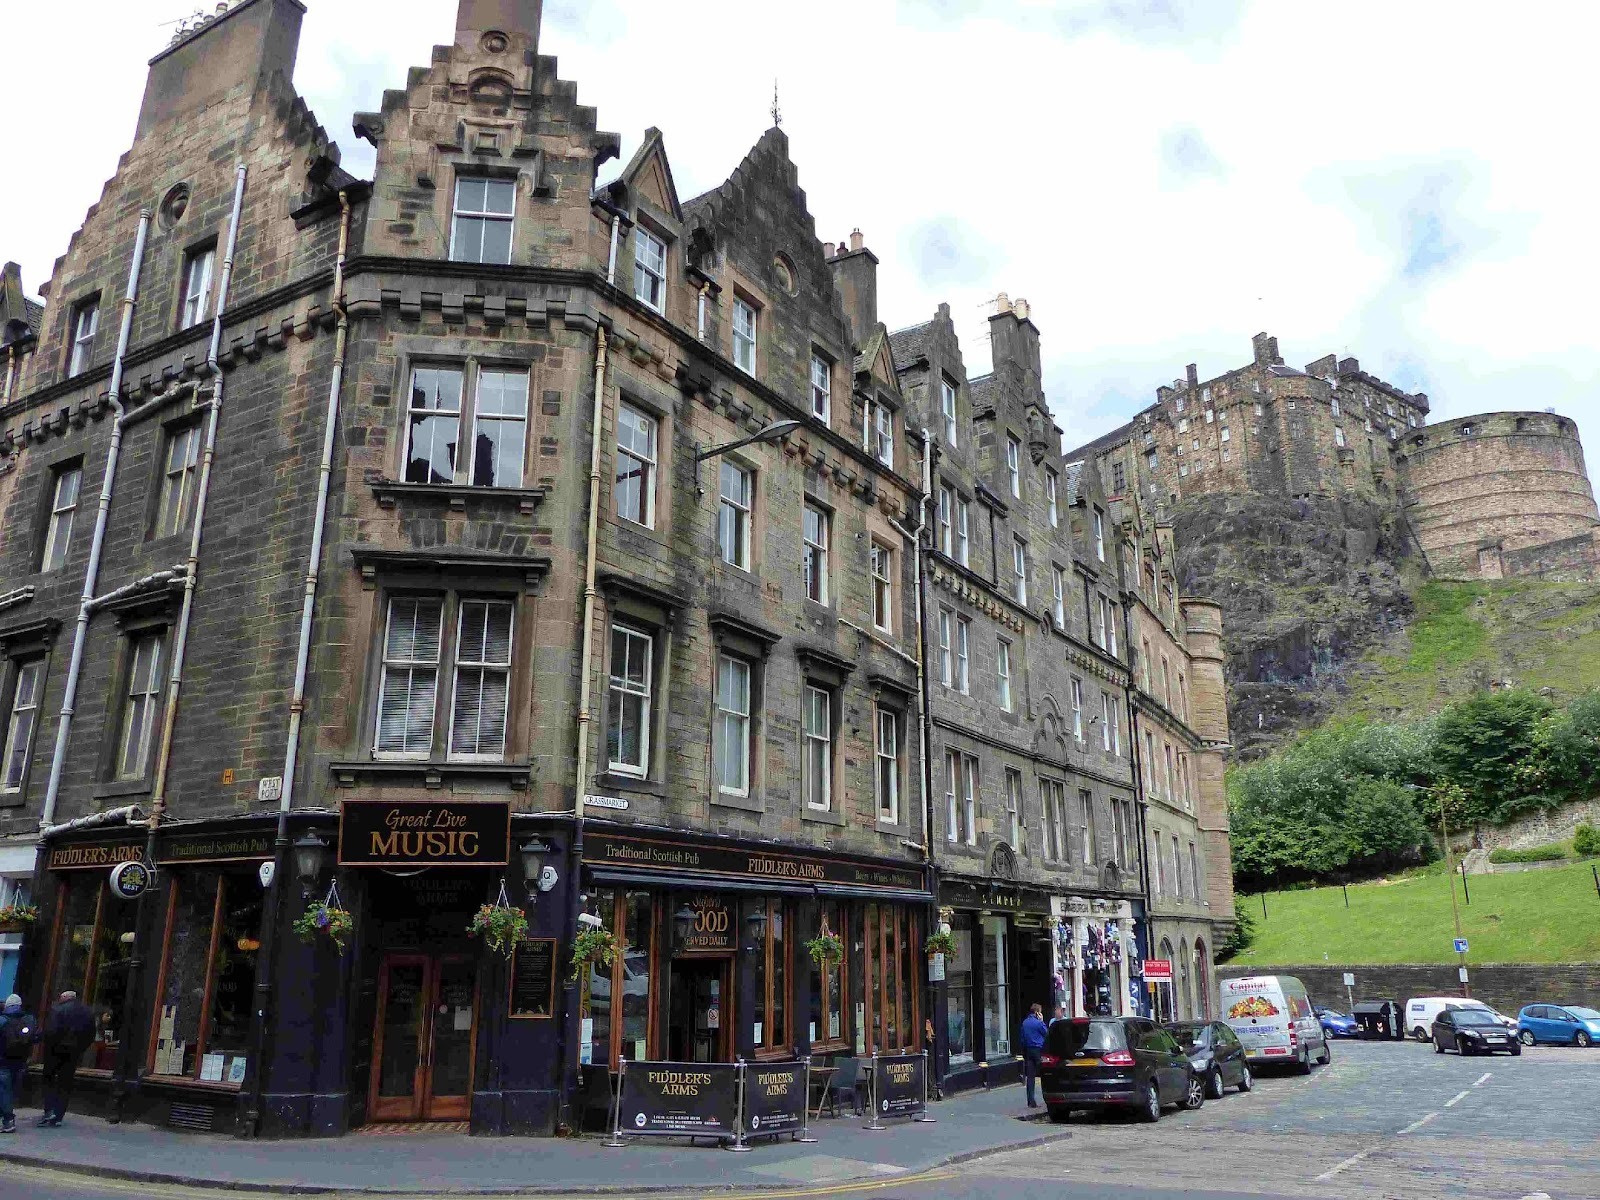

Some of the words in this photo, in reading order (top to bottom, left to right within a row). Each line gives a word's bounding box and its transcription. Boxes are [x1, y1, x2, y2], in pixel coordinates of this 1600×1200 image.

[263, 779, 280, 789] WEST
[262, 789, 278, 798] PORT
[585, 796, 626, 809] GRASSMARKET
[385, 809, 432, 829] Great
[433, 809, 467, 828] Live
[170, 841, 214, 857] Traditional
[216, 840, 248, 853] Scottish
[250, 839, 268, 851] Pub
[369, 831, 479, 857] MUSIC
[54, 846, 108, 864] FIDDLER'S
[109, 845, 143, 861] ARMS
[605, 844, 651, 860] Traditional
[652, 848, 683, 863] Scottish
[685, 852, 700, 865] Pub
[748, 856, 796, 876] FIDDLER'S
[798, 864, 825, 879] ARMS
[694, 906, 729, 932] OOD
[709, 936, 728, 946] DAILY
[648, 1070, 711, 1085] FIDDLER'S
[757, 1072, 794, 1085] FIDDLER'S
[661, 1083, 699, 1096] ARMS
[766, 1083, 788, 1096] ARMS
